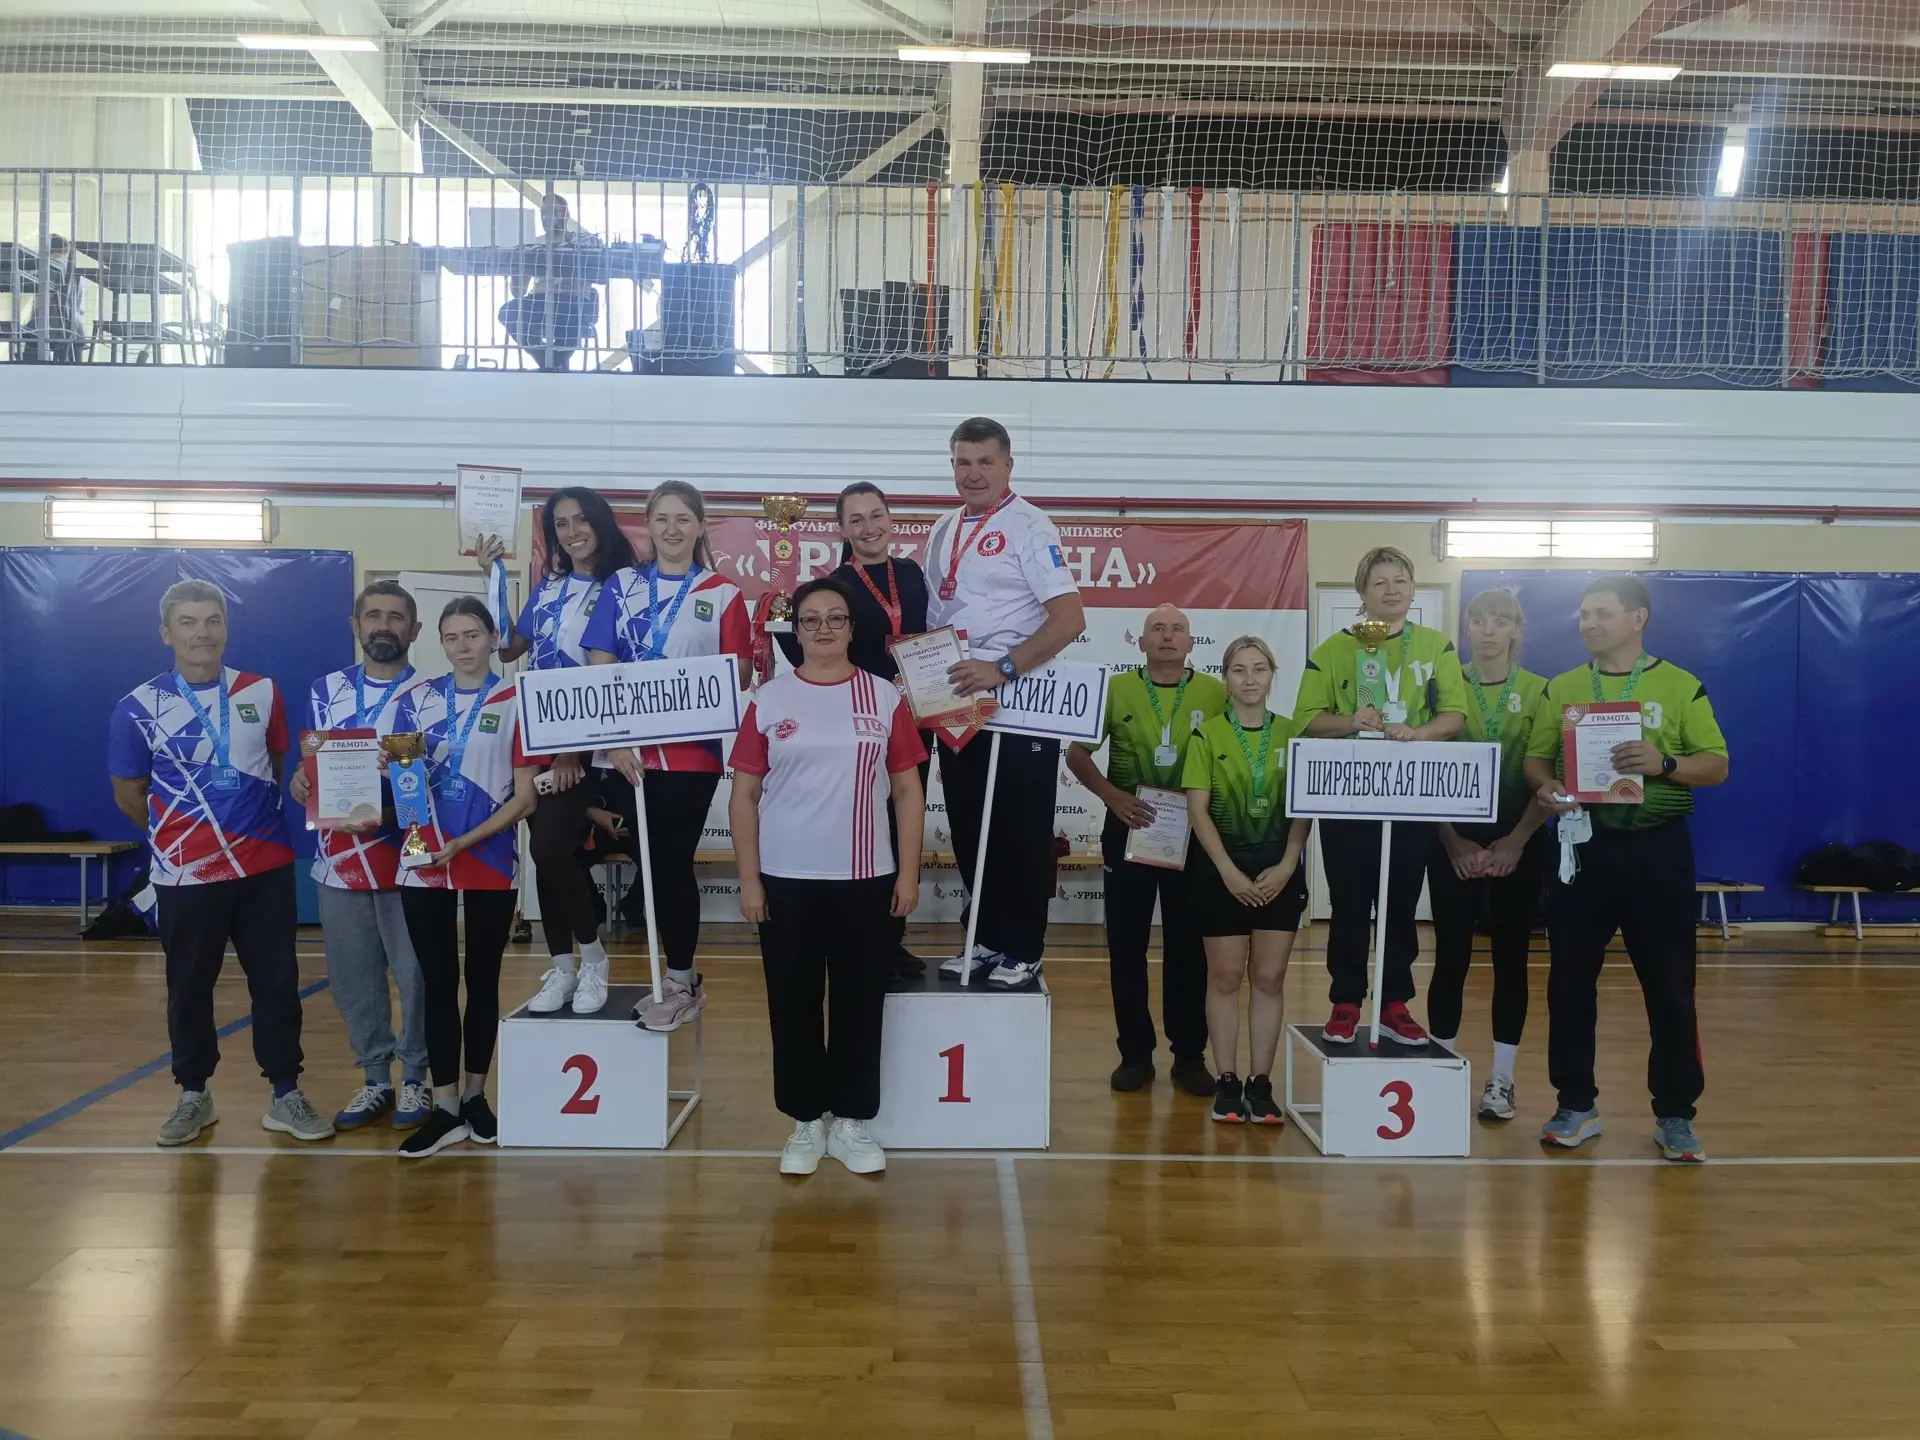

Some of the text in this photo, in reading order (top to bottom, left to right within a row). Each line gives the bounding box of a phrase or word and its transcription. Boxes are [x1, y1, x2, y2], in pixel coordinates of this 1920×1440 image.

[1059, 526, 1123, 538] МПЛЕКС
[902, 641, 952, 659] БЛАГОДАРСТВЕННОЕ
[918, 651, 941, 661] ПИСЬМО
[535, 668, 721, 725] МОЛОДЁЖНЫЙ АО
[990, 669, 1057, 715] СКИЙ
[1058, 681, 1088, 718] АО
[1507, 692, 1522, 713] 3
[1591, 714, 1631, 723] ГРАМОТА
[1643, 701, 1663, 730] 3
[331, 740, 370, 749] ГРАМОТА
[1306, 759, 1481, 799] ШИРЯЕВСКАЯ ШКОЛА
[699, 885, 740, 895] «УРИК-А
[1073, 891, 1105, 900] «УРИК
[939, 1043, 971, 1103] 1
[560, 1053, 601, 1115] 2
[1376, 1080, 1416, 1140] 3
